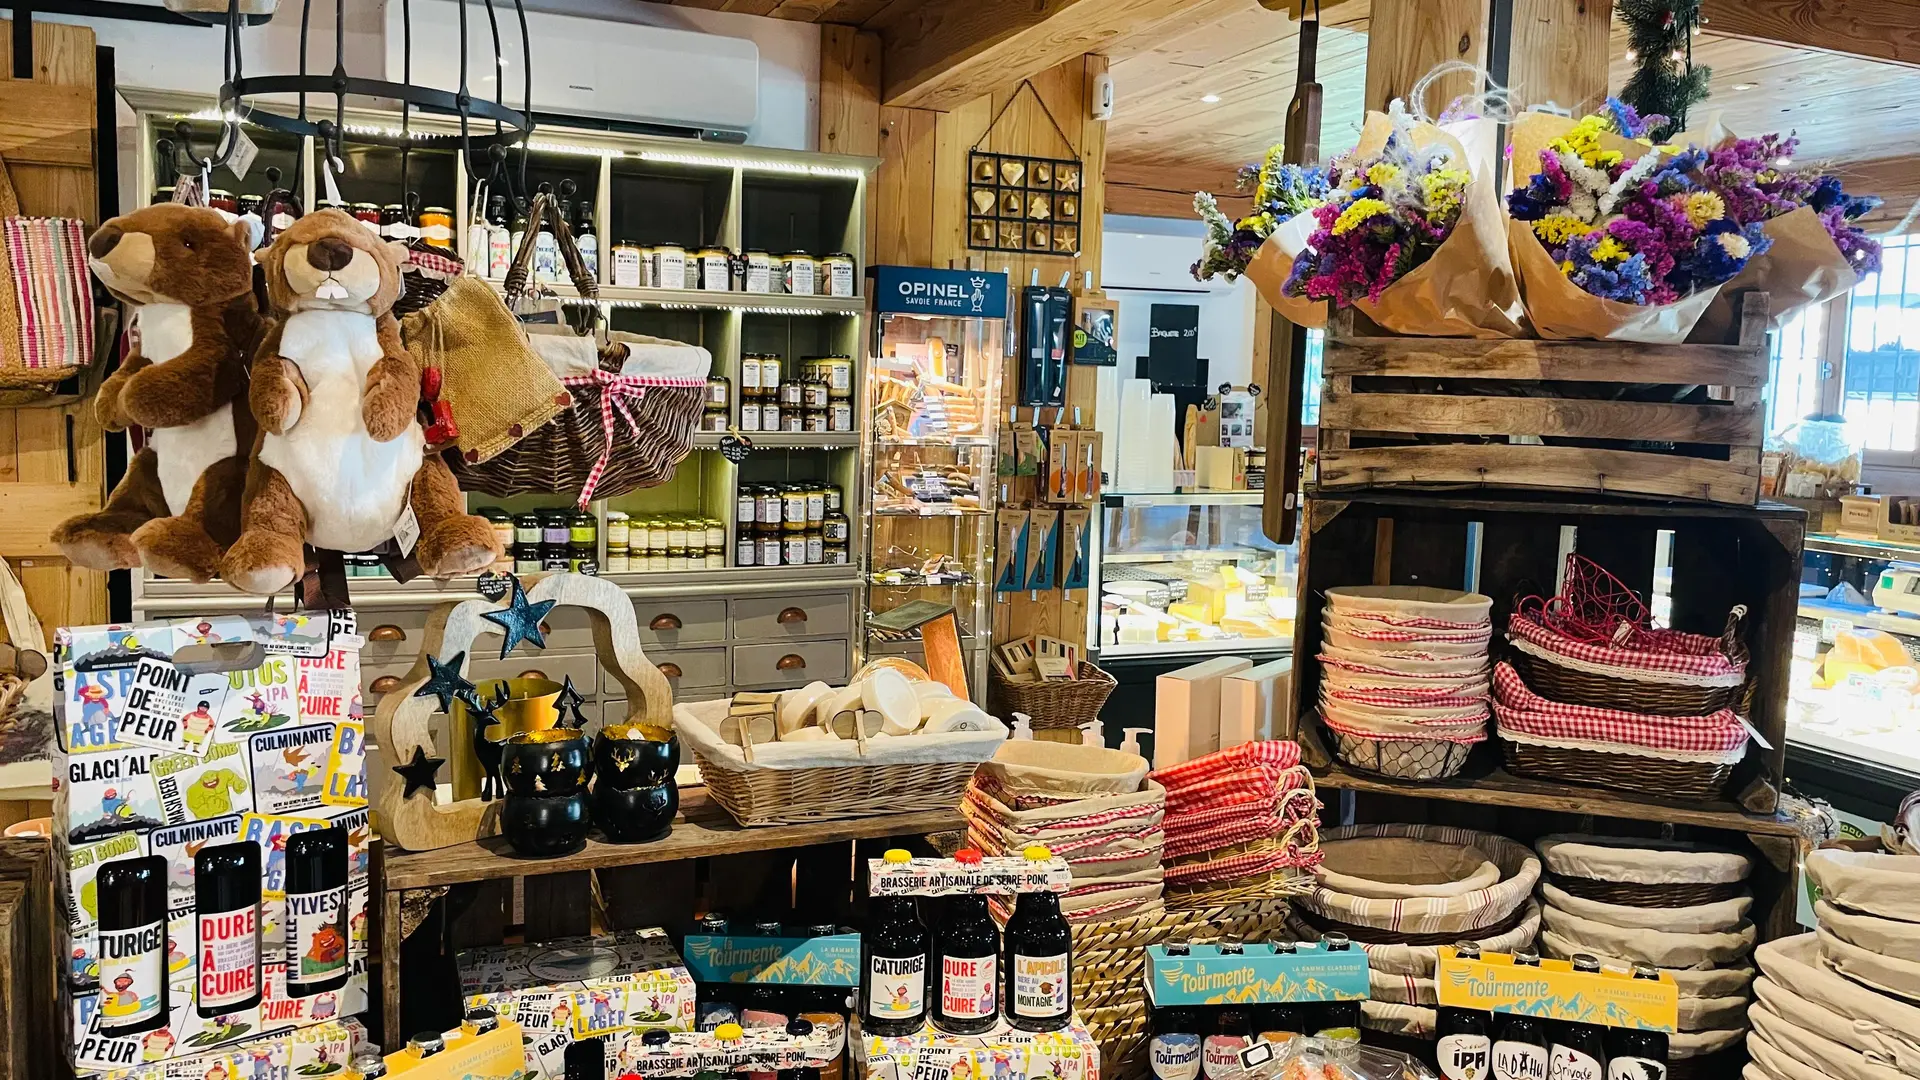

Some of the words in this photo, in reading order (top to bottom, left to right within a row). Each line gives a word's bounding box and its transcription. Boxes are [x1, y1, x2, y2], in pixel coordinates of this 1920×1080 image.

[898, 281, 969, 299] OPINEL
[905, 298, 930, 306] SAVOIE
[934, 298, 962, 308] FRANCE
[1075, 333, 1085, 342] KIT
[136, 662, 195, 693] POINT
[128, 687, 155, 711] DE
[266, 687, 289, 702] IPA
[121, 719, 178, 743] PEUR
[255, 727, 333, 752] CULMINANTE
[155, 819, 239, 847] CULMINANTE
[96, 836, 138, 861] BOMB
[880, 875, 926, 888] BRASSERIE
[929, 873, 980, 887] ARTISANALE
[984, 874, 994, 885] DE
[202, 909, 255, 942] DURE
[98, 923, 162, 960] TURIGE
[286, 918, 299, 981] MYRTILLE
[724, 936, 733, 950] la
[202, 944, 215, 972] À
[708, 946, 783, 967] Tourmente
[873, 955, 924, 976] CATURIGE
[944, 958, 977, 977] DURE
[1196, 961, 1206, 975] la
[1485, 968, 1494, 981] la
[202, 965, 255, 997] CUIRE
[632, 980, 678, 993] LOTUS
[1181, 964, 1255, 994] Tourmente
[1468, 977, 1549, 998] Tourmente
[519, 1001, 534, 1011] DE
[521, 993, 554, 1001] POINT
[660, 994, 675, 1004] IPA
[944, 995, 976, 1013] CUIRE
[1017, 994, 1053, 1008] MONTAGNE
[516, 1013, 549, 1028] PEUR
[577, 1010, 625, 1034] LAGER
[80, 1038, 138, 1064] PEUR
[328, 1042, 345, 1054] IPA
[920, 1047, 953, 1055] POINT
[1034, 1045, 1081, 1060] LOTUS
[1155, 1048, 1199, 1066] Tourmente
[1166, 1046, 1172, 1054] la
[1215, 1046, 1221, 1054] la
[166, 1058, 203, 1069] POINT
[636, 1057, 684, 1072] BRASSERIE
[686, 1053, 741, 1069] ARTISANALE
[742, 1055, 752, 1065] DE
[1064, 1059, 1078, 1072] IPA
[1205, 1049, 1239, 1066] Tourme
[1511, 1051, 1544, 1079] DAHU
[915, 1065, 949, 1080] PEUR
